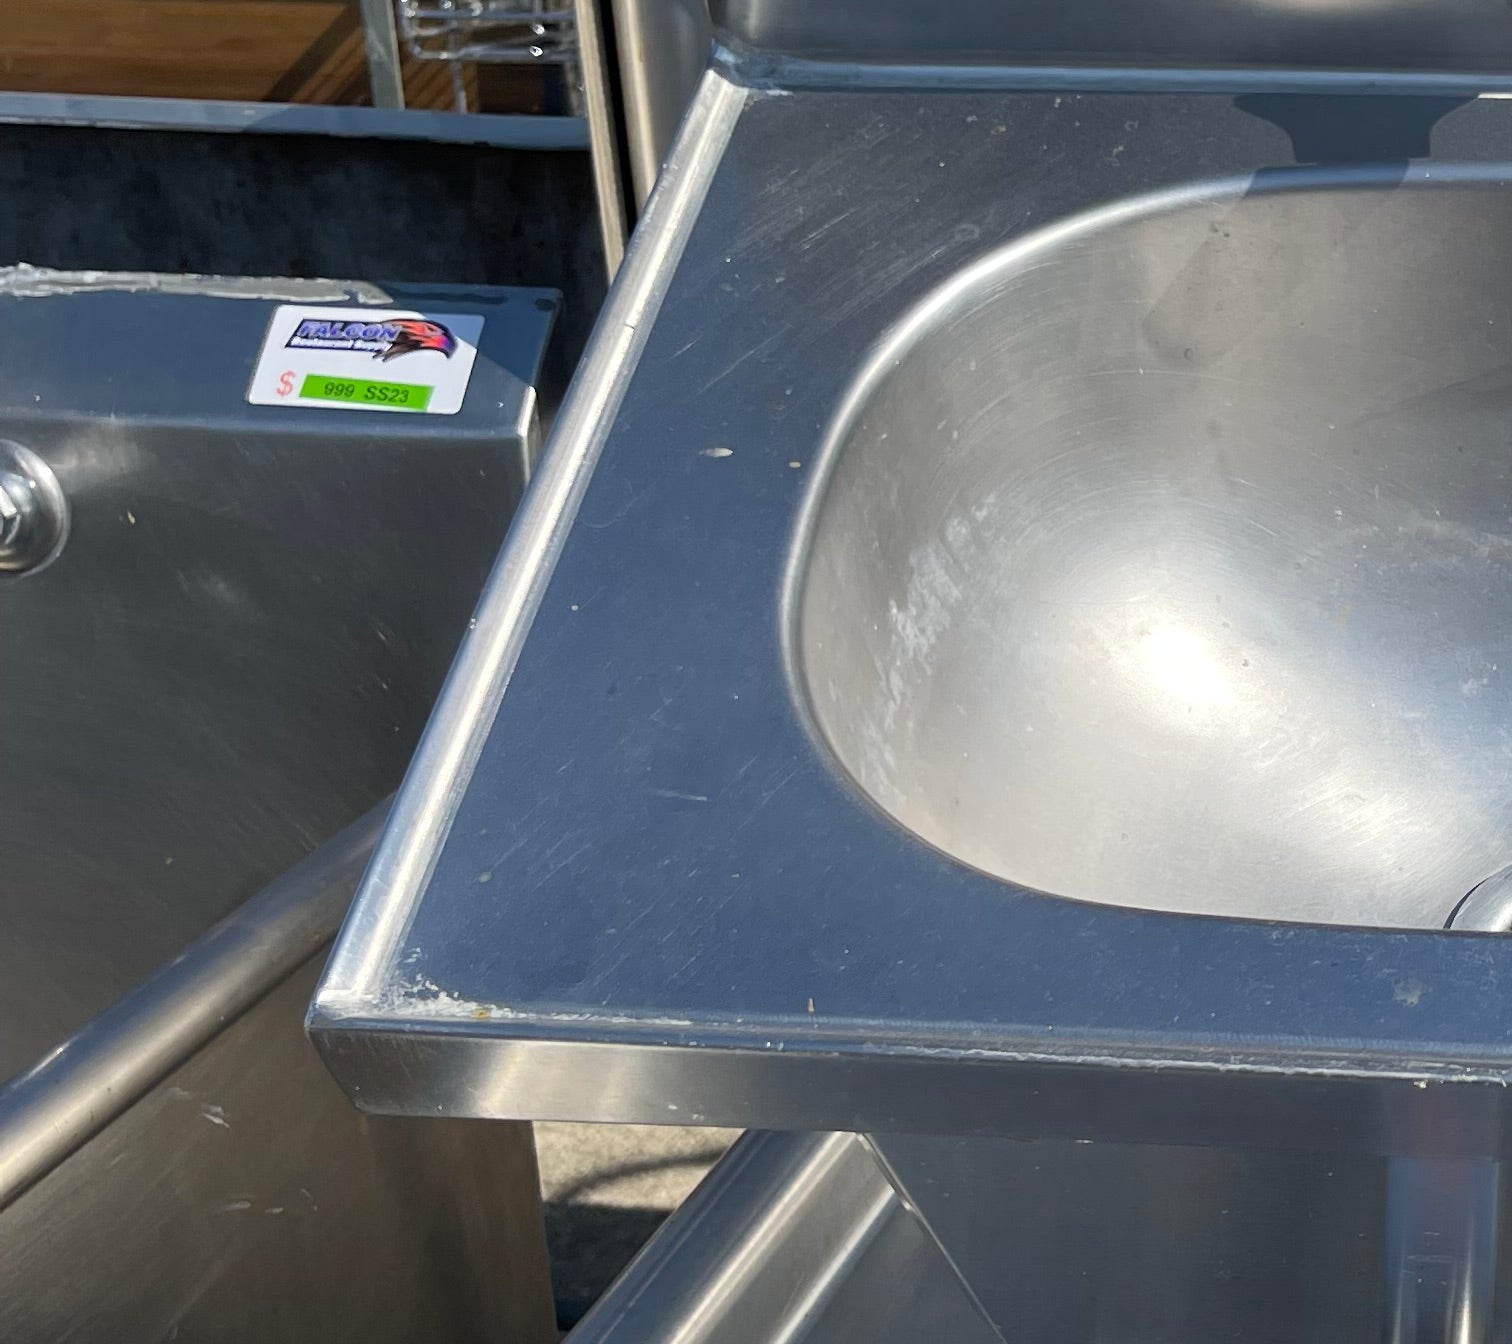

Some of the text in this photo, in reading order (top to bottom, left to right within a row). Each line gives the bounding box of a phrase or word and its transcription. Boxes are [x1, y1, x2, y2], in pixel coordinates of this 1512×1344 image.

[297, 321, 402, 341] FALCON
[275, 370, 410, 404] $ 999 SS23
